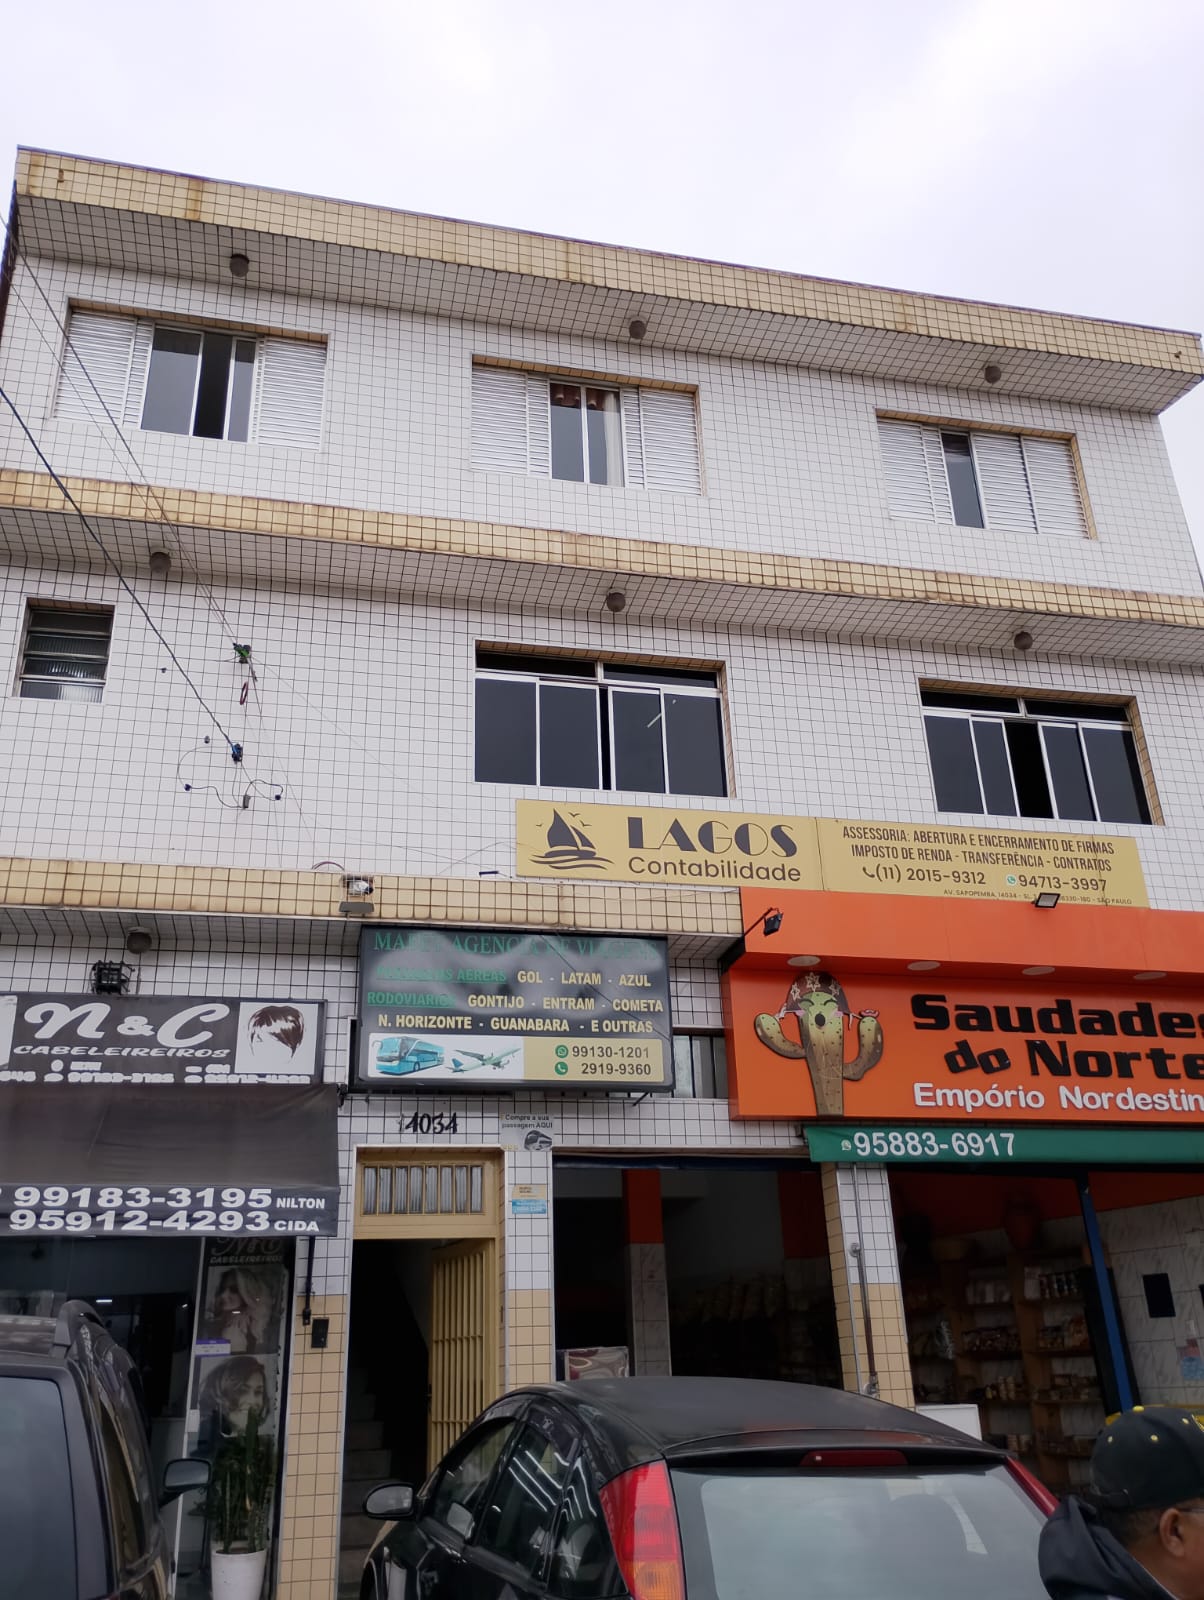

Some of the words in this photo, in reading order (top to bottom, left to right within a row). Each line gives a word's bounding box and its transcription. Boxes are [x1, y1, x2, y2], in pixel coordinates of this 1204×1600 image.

[627, 816, 797, 857] LAGOS
[842, 826, 911, 842] ASSESSORIA:
[913, 830, 967, 845] ABERTURA
[969, 834, 977, 846] E
[979, 834, 1060, 852] ENCERRAMENTO
[1062, 840, 1075, 852] DE
[1077, 840, 1115, 855] FIRMAS
[628, 856, 801, 881] Contabilidade
[851, 844, 899, 859] IMPOSTO
[901, 847, 915, 860] DE
[917, 848, 952, 862] RENDA
[961, 850, 1044, 868] TRANSFERÊNCIA
[1053, 856, 1112, 872] CONTRATOS
[876, 863, 901, 883] (11)
[906, 867, 986, 885] 2015-9312
[1018, 874, 1107, 892] 94713-3997
[517, 971, 543, 983] GOL
[561, 972, 602, 985] LATAM
[619, 974, 652, 987] AZUL
[467, 994, 525, 1009] GONTIJO
[543, 996, 595, 1010] ENTRAM
[612, 998, 664, 1012] COMETA
[378, 1014, 392, 1027] N.
[395, 1014, 473, 1029] HORIZONTE
[490, 1017, 570, 1032] GUANABARA
[591, 1020, 600, 1032] E
[602, 1020, 654, 1033] OUTRAS
[910, 993, 1204, 1038] Saudade
[13, 1045, 231, 1058] CABELEIREIROS
[572, 1045, 650, 1058] 99130-1201
[943, 1039, 1011, 1075] do
[581, 1063, 652, 1076] 2919-9360
[913, 1082, 1045, 1113] Empório
[505, 1113, 531, 1121] Compre
[853, 1132, 1015, 1156] 95883-6917
[14, 1187, 272, 1208] 99183-3195
[276, 1197, 325, 1209] NILTON
[9, 1209, 271, 1232] 95912-4293
[273, 1220, 320, 1232] CIDA
